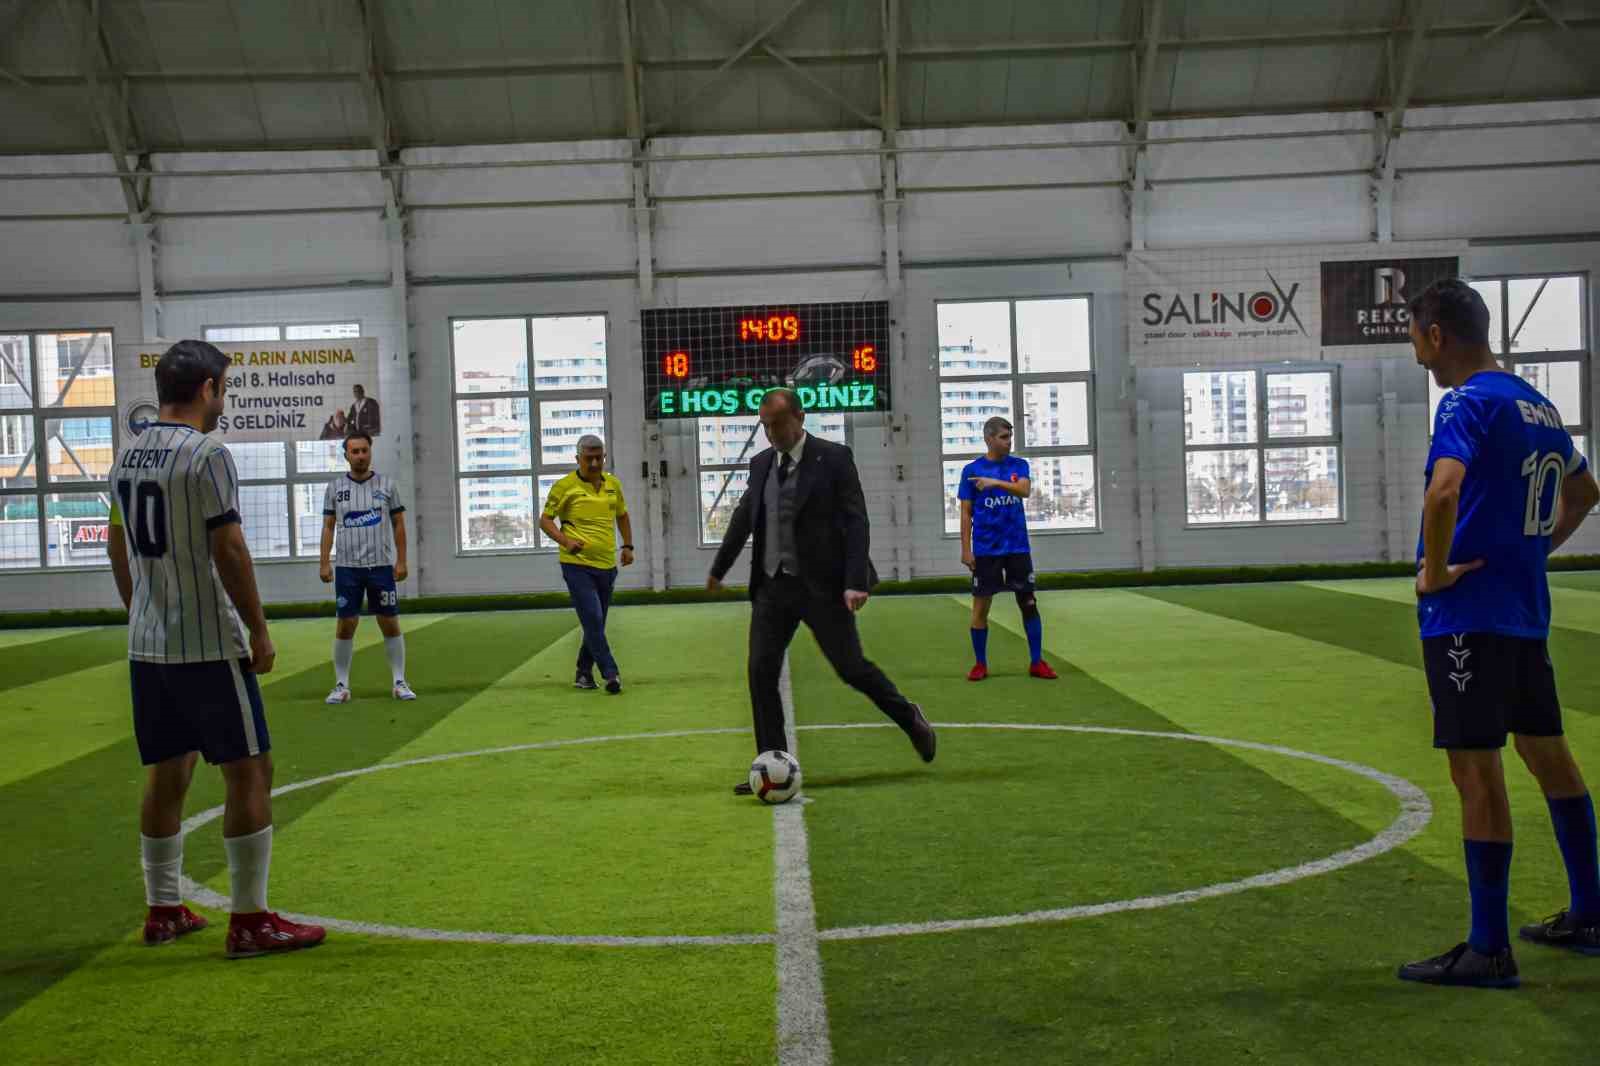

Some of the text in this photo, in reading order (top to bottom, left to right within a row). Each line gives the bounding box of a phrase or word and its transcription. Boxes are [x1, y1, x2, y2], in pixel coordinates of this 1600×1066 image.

[1357, 307, 1410, 325] REKO
[741, 316, 798, 340] 14:09
[247, 351, 286, 365] ARIN
[289, 349, 355, 365] ANISINA
[854, 347, 876, 371] 16
[268, 370, 335, 386] Halısaha
[228, 394, 324, 409] Turnuvasına
[681, 390, 740, 414] HOŞ
[745, 381, 875, 410] GDİNİZ
[233, 409, 306, 430] GELDİNİZ
[121, 448, 172, 469] LEVENT
[336, 491, 351, 502] 38
[1521, 450, 1565, 536] 10
[117, 480, 167, 559] 10
[380, 591, 396, 606] 38
